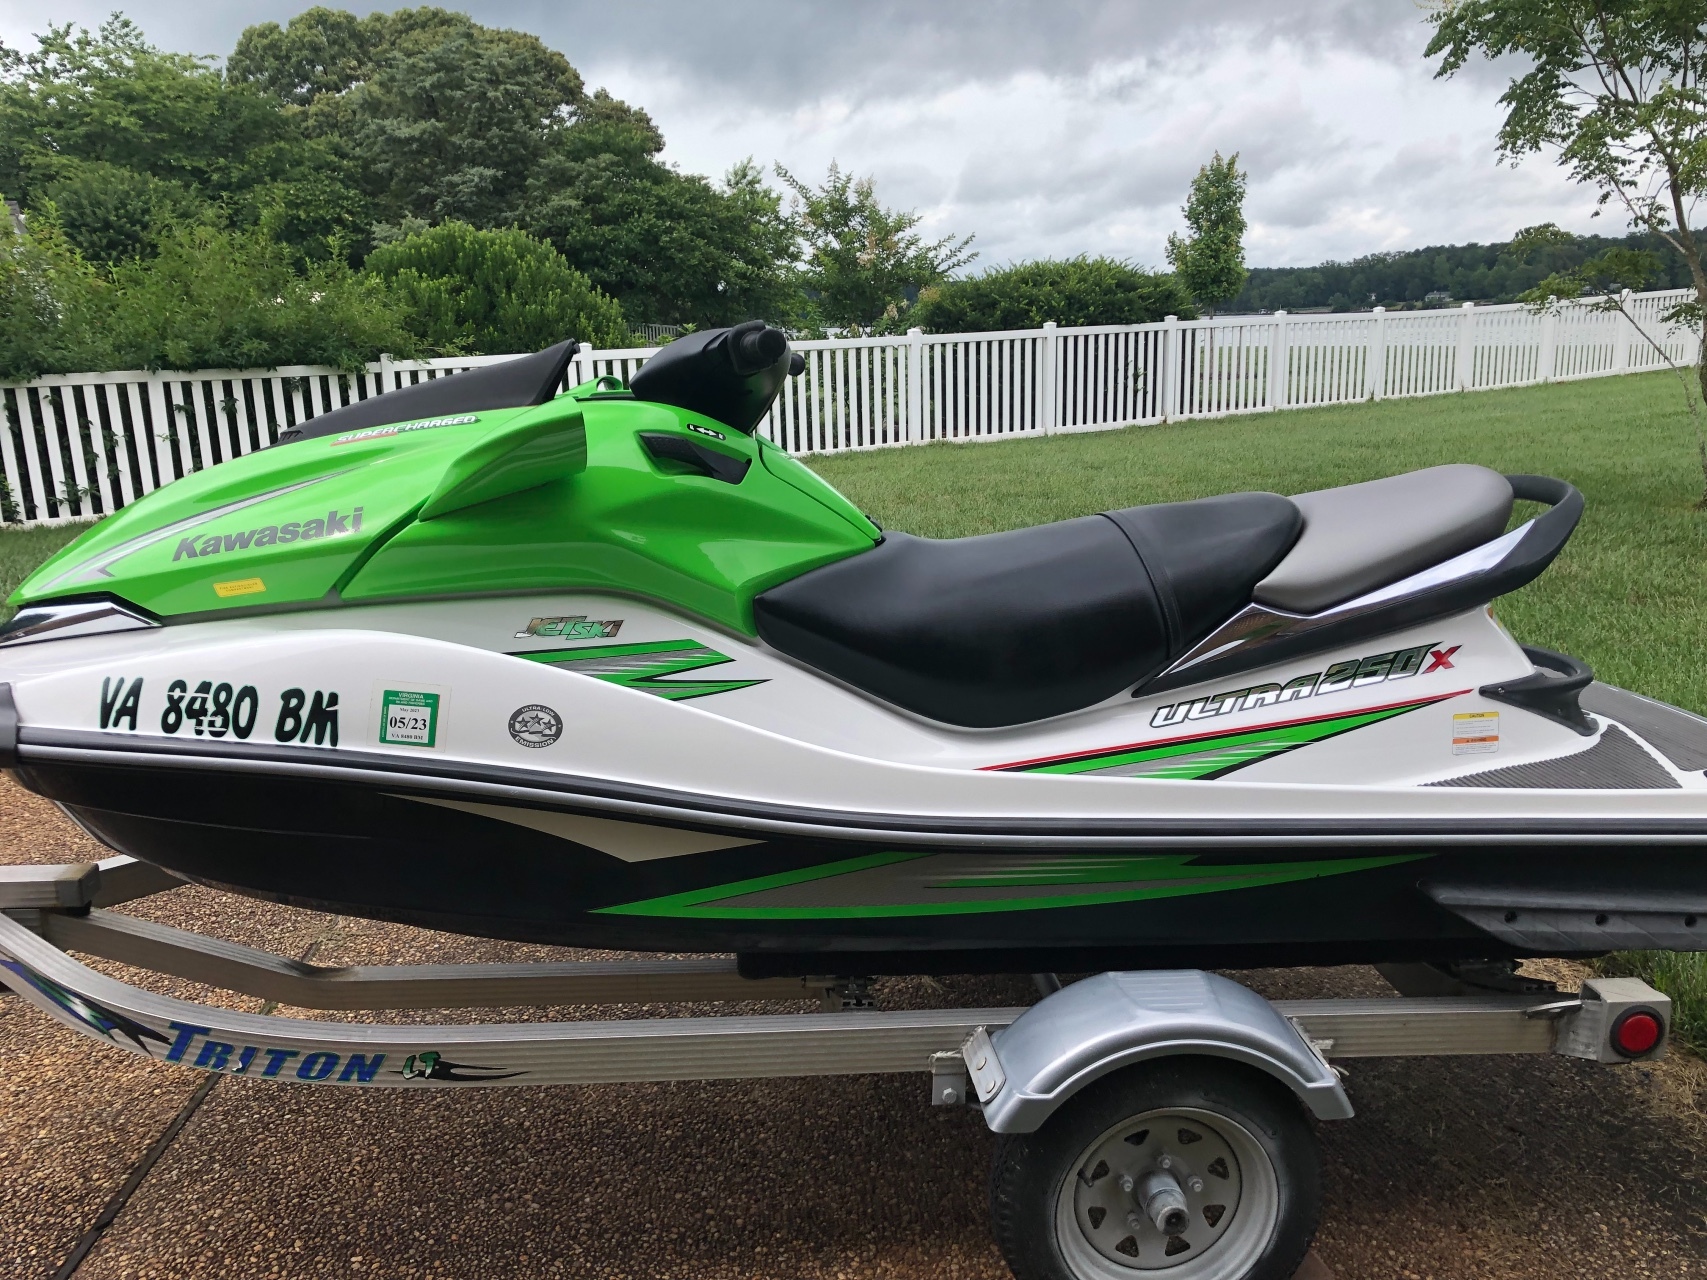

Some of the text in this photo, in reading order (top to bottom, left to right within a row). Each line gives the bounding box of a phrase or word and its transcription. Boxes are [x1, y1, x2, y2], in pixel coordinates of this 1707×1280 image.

[335, 415, 477, 443] SUPERCHARGED
[172, 506, 364, 562] Kawasaki
[398, 692, 424, 700] VIRGINIA
[100, 676, 144, 731] VA
[161, 679, 259, 740] 8480
[274, 687, 339, 747] BM
[389, 715, 427, 731] 05/23
[514, 735, 554, 749] EMISSION
[165, 1021, 388, 1085] TRITON
[402, 1051, 441, 1080] LT
